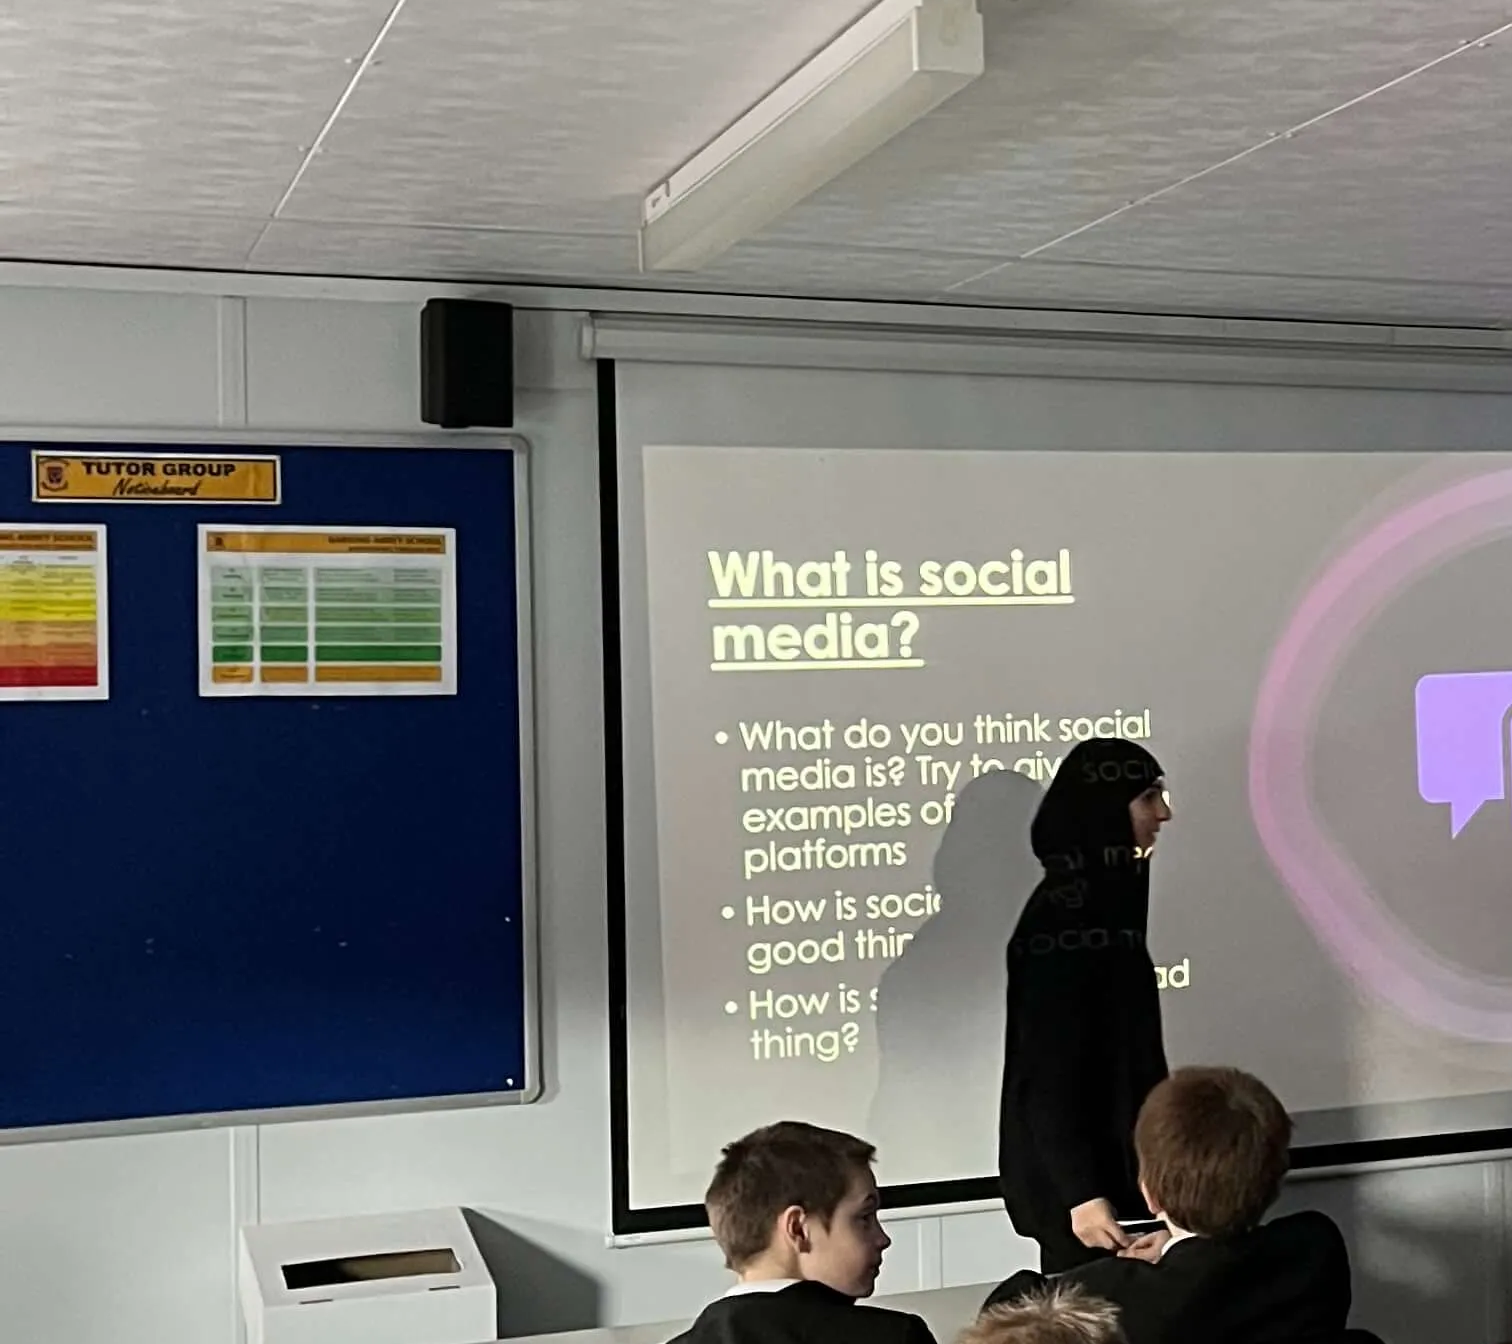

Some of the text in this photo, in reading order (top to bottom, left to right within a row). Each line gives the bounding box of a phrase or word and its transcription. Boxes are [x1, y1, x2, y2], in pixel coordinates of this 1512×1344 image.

[81, 462, 236, 478] TUTOR GROUP
[707, 548, 1072, 597] What is social
[712, 610, 921, 661] media?
[738, 708, 1151, 754] What do you think social
[741, 758, 856, 791] media
[864, 755, 906, 789] is?
[914, 755, 962, 791] Try
[1013, 750, 1065, 781] giv
[742, 792, 956, 836] examples of
[744, 837, 907, 880] platforms
[746, 884, 942, 927] How is soci
[747, 929, 845, 974] good
[749, 988, 830, 1020] How
[838, 982, 861, 1014] is
[1153, 957, 1190, 990] ad
[750, 1021, 860, 1063] thing?
